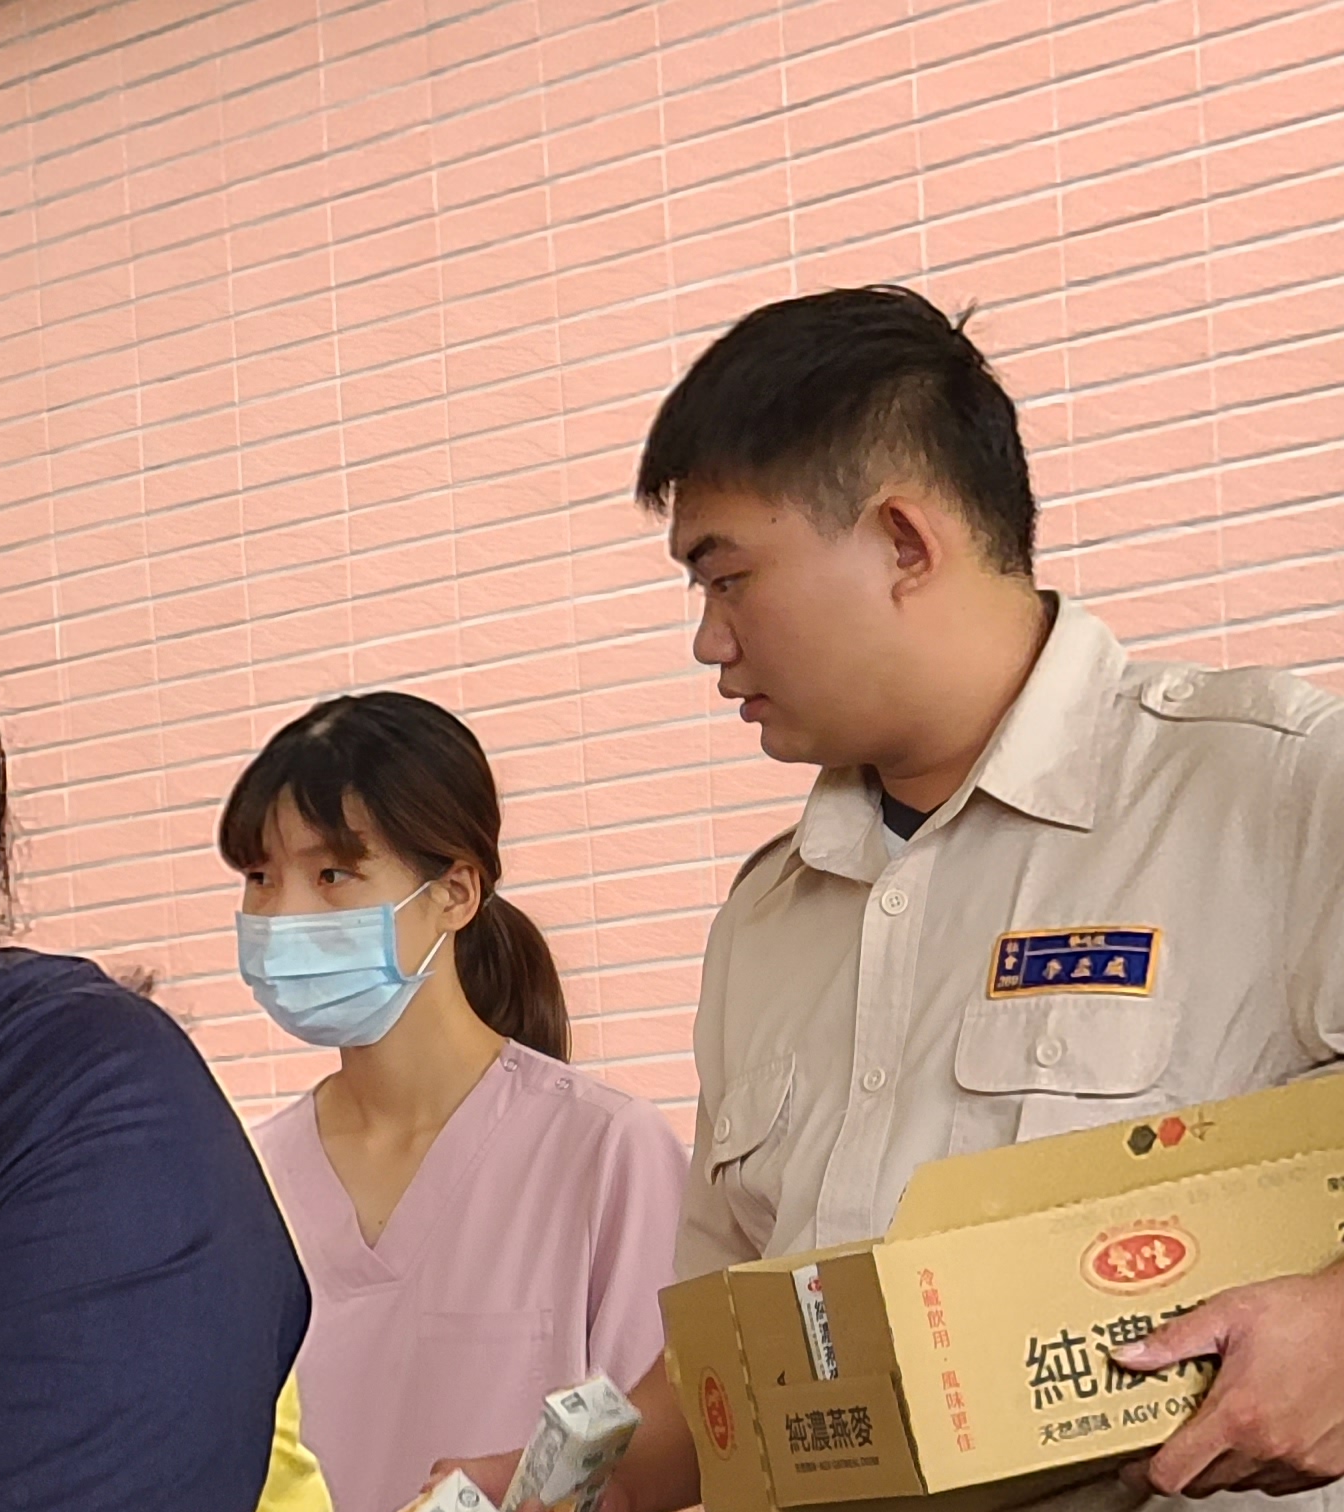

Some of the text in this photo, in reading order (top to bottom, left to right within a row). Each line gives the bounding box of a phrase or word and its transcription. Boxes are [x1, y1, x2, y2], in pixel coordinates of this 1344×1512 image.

[1025, 1300, 1214, 1410] 純濃
[785, 1405, 873, 1454] 純濃燕麥
[1122, 1402, 1160, 1427] AGV
